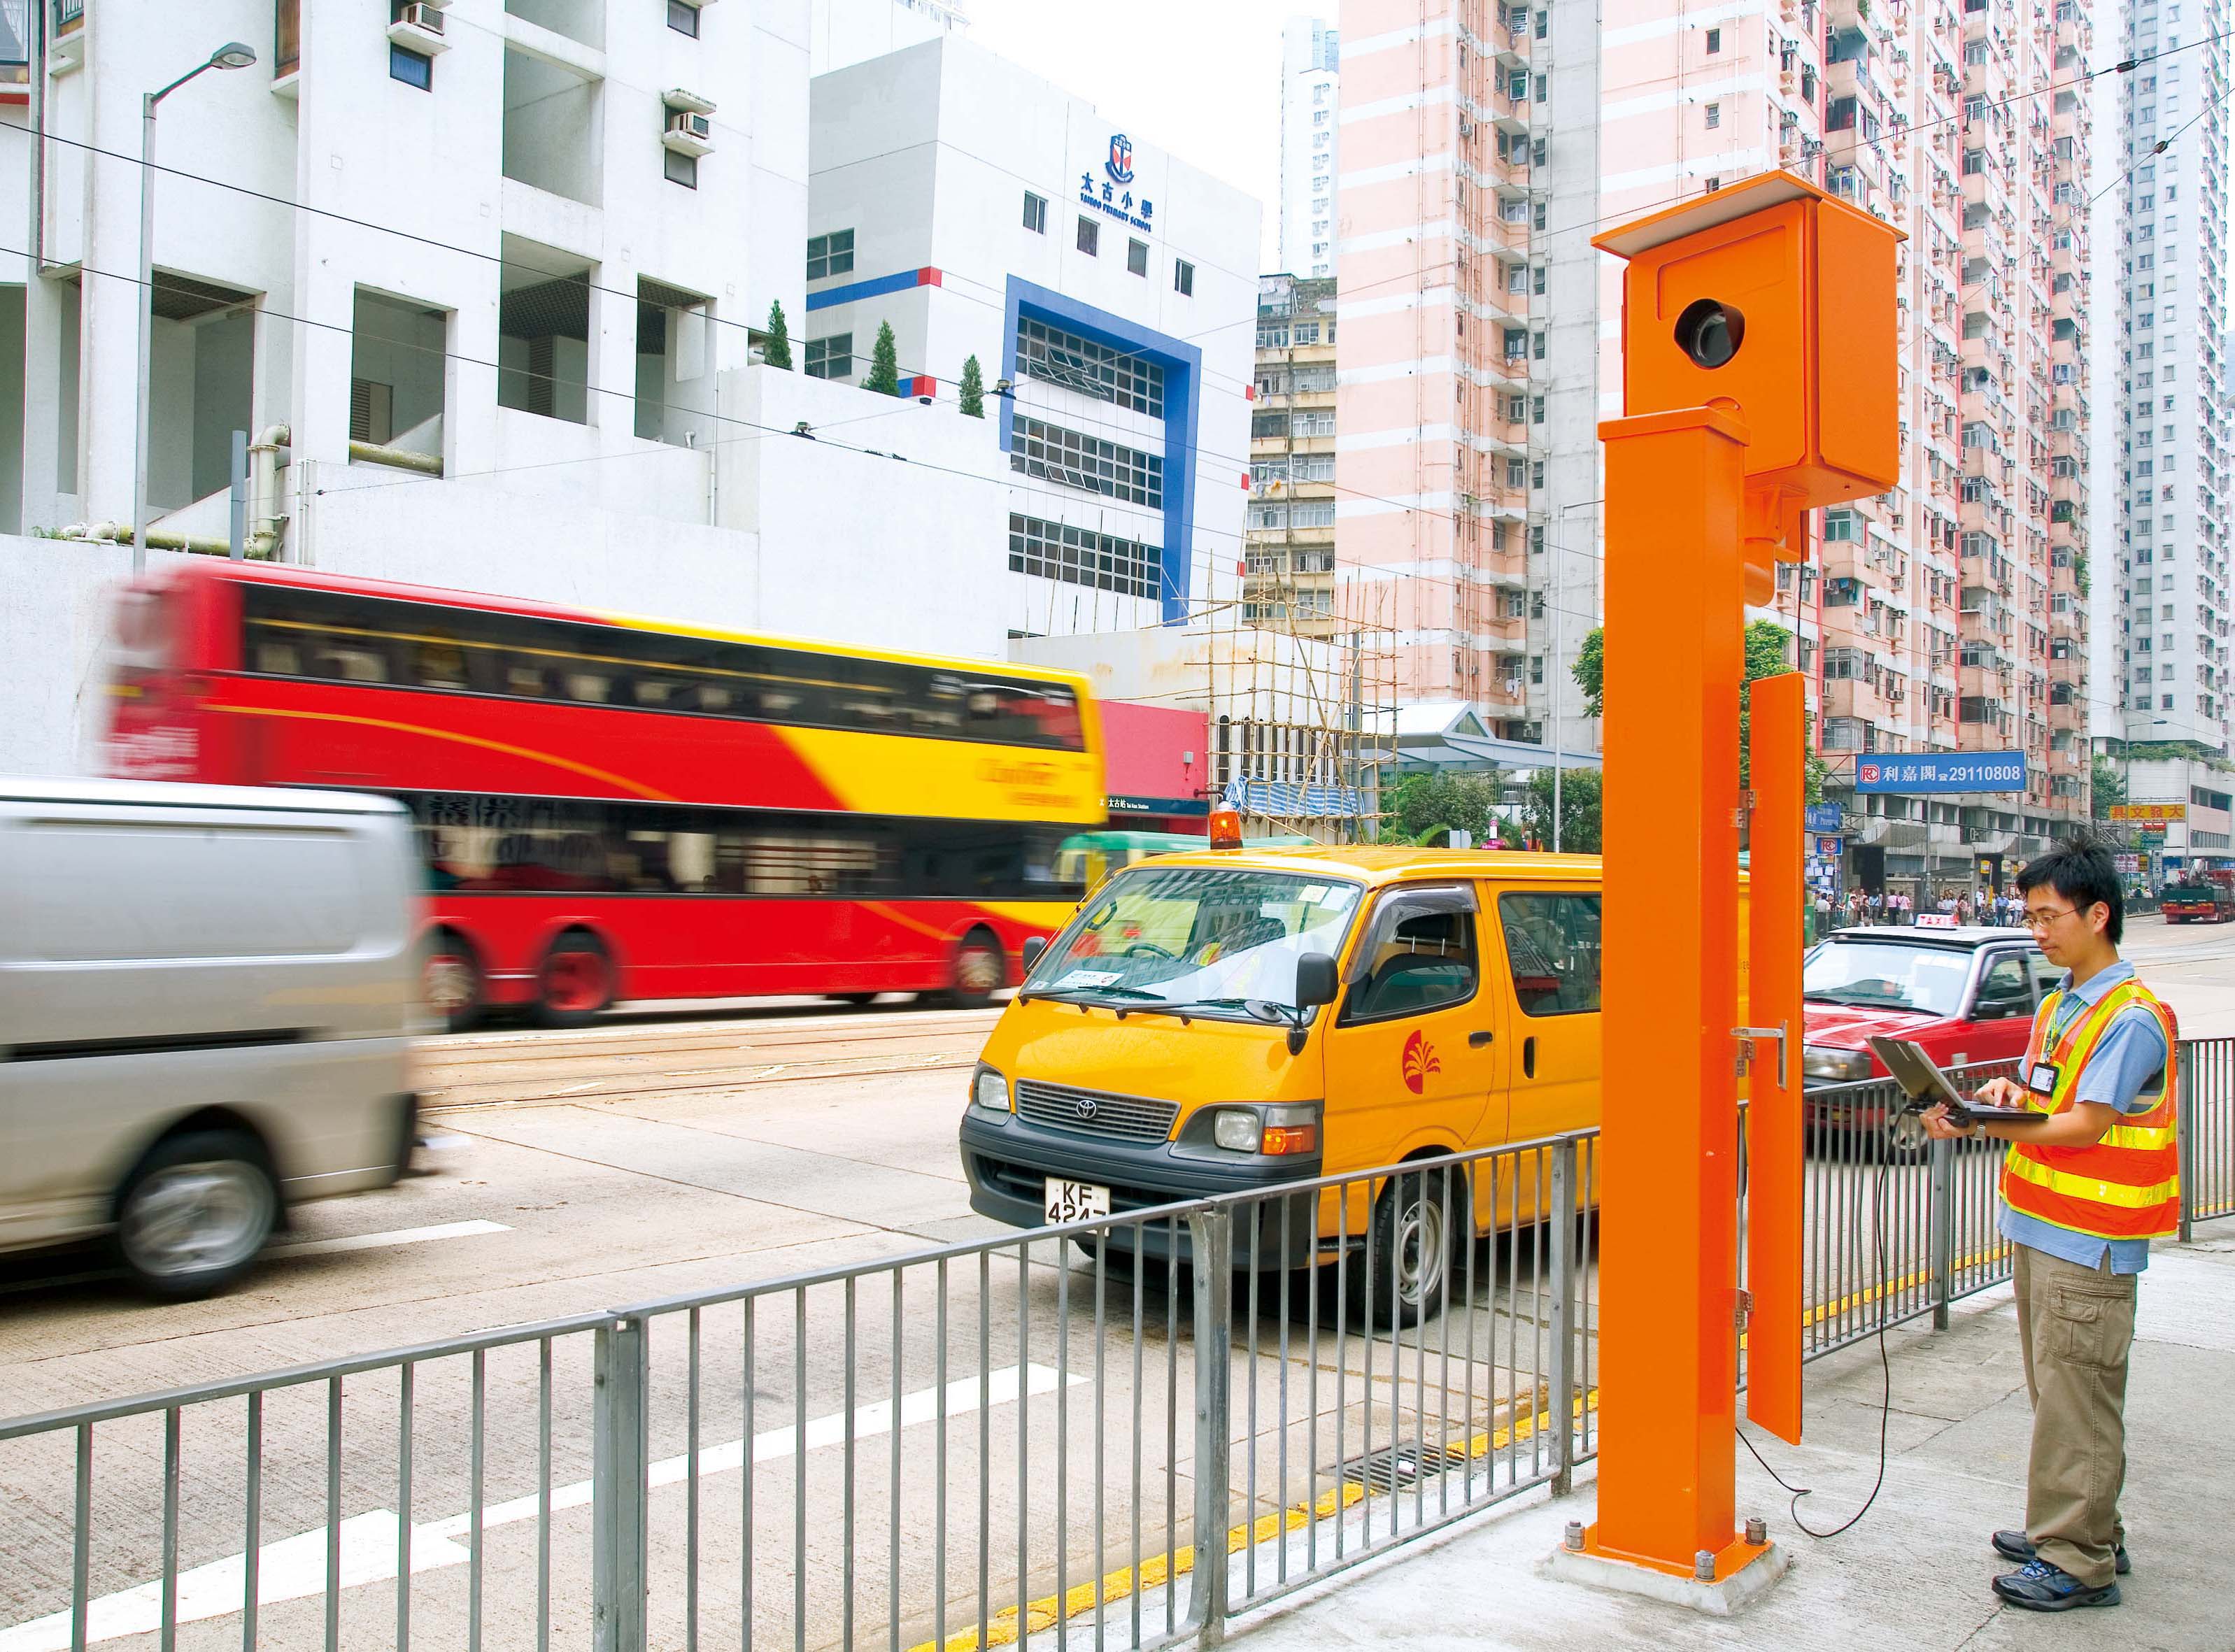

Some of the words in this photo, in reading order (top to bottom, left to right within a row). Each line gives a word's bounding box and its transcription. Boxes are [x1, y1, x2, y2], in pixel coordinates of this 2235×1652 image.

[1081, 172, 1153, 219] 太古小學
[1080, 192, 1102, 209] TAIKOO
[1102, 204, 1129, 222] PRIMARY
[1130, 216, 1151, 233] SCHOOL
[1882, 765, 1936, 782] 利嘉閣
[1949, 766, 2021, 781] 29110808
[1108, 798, 1126, 809] 太古站
[1063, 1182, 1092, 1206] KF
